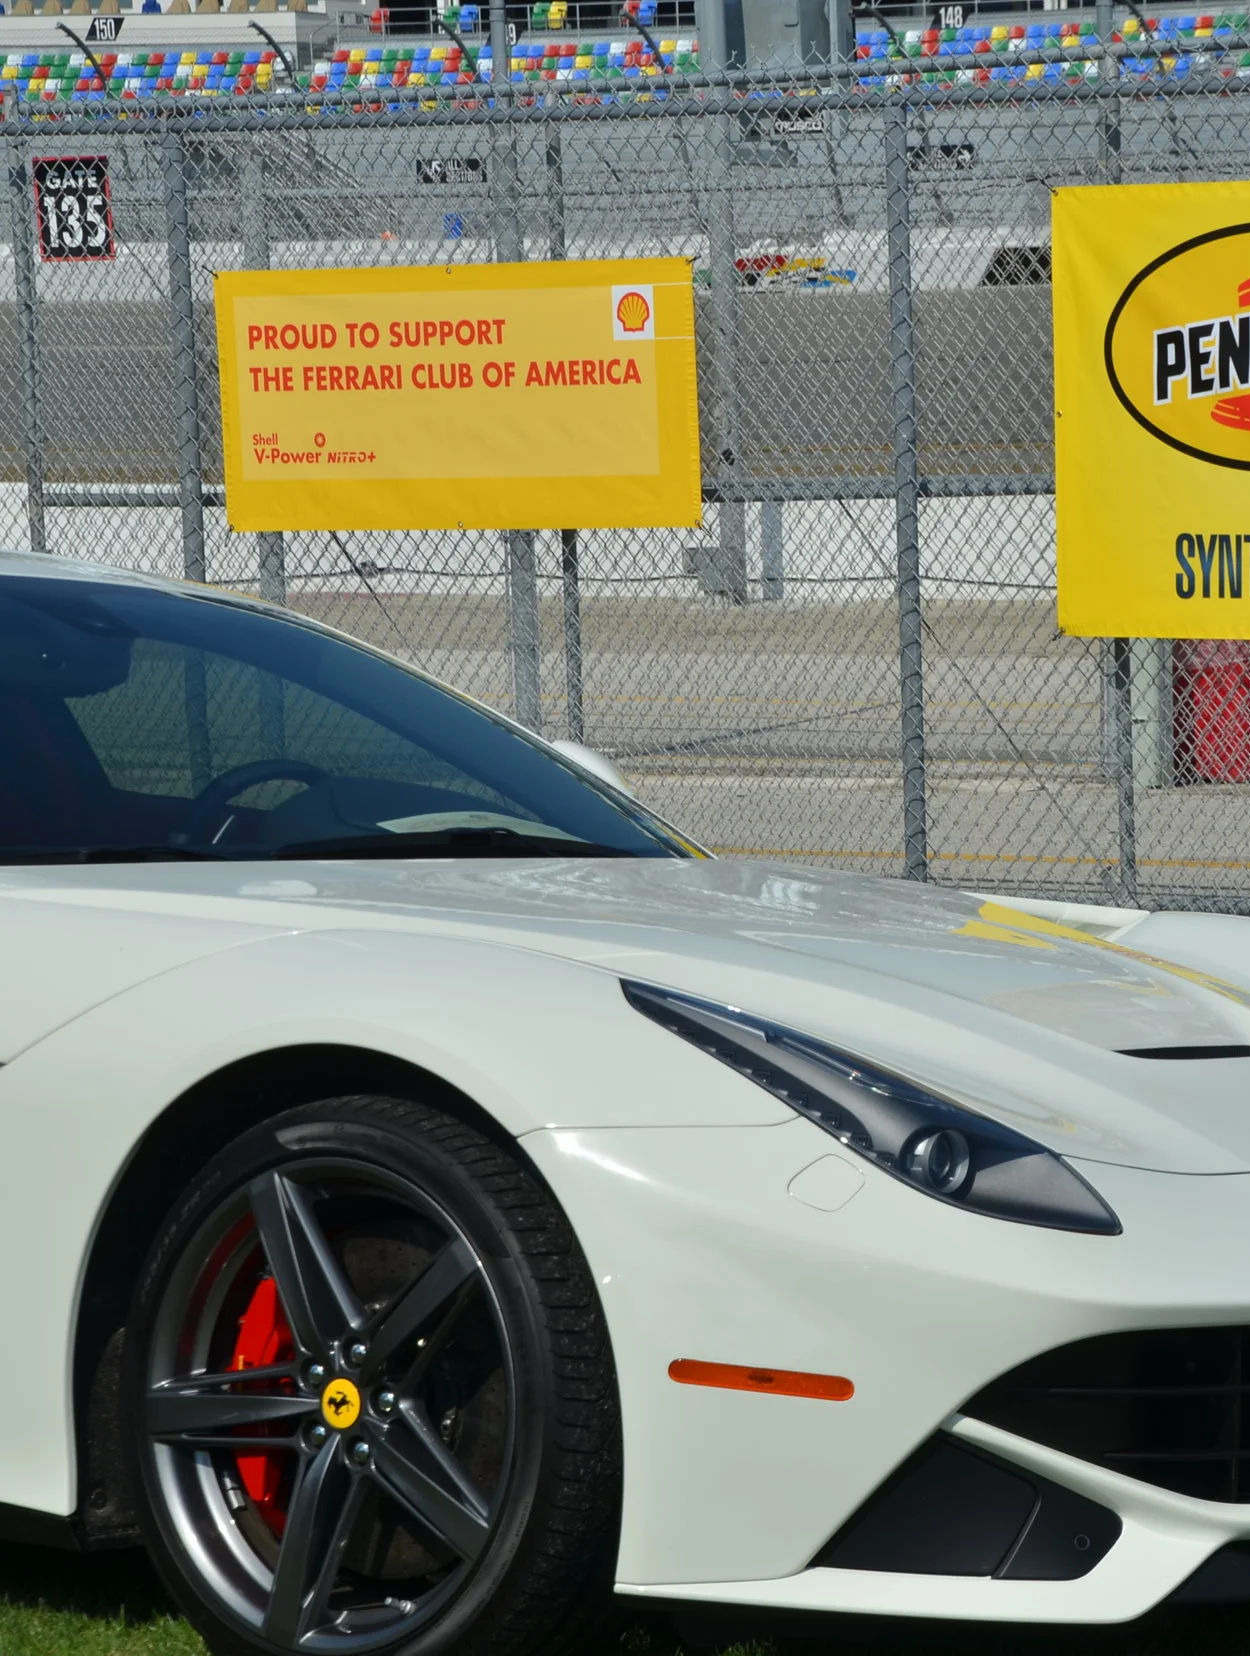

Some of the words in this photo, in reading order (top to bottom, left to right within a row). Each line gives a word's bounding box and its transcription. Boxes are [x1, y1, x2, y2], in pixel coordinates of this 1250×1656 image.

[939, 5, 964, 29] 148
[94, 18, 116, 40] 150
[45, 169, 100, 190] GATE
[43, 195, 106, 248] 135
[248, 324, 337, 350] PROUD
[345, 322, 380, 348] TO
[389, 319, 506, 348] SUPPORT
[249, 367, 294, 392] THE
[303, 365, 403, 391] FERRARI
[411, 363, 474, 389] CLUB
[482, 361, 516, 388] OF
[525, 358, 642, 387] AMERICA
[252, 432, 278, 446] Shell
[254, 448, 322, 464] V-Power
